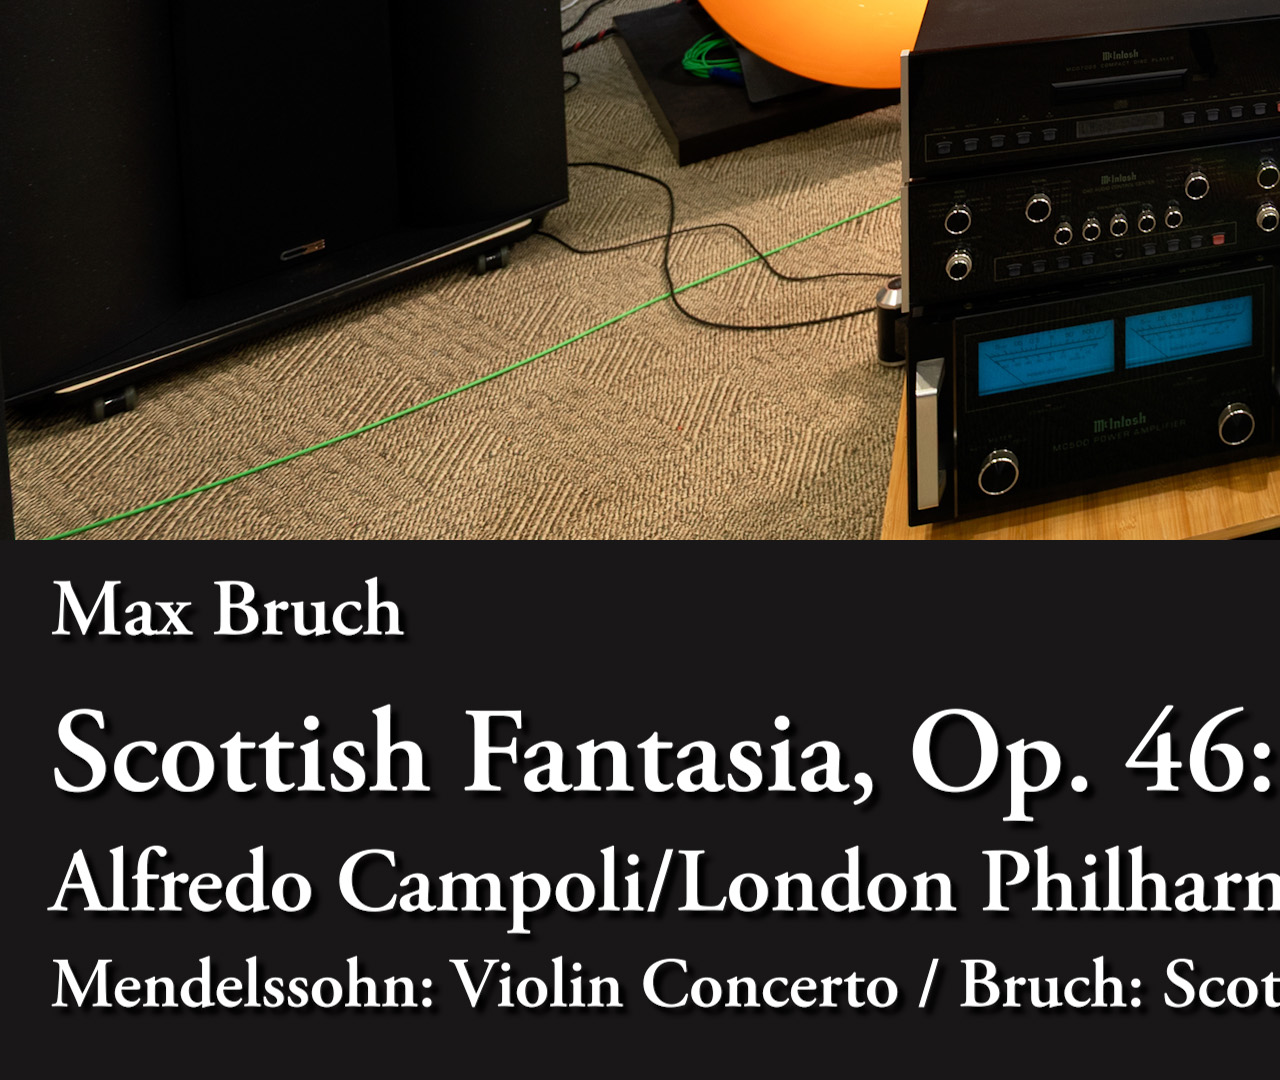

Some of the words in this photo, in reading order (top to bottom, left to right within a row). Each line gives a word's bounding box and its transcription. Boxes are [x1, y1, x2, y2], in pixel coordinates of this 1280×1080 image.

[1093, 411, 1147, 433] McIntosh
[1093, 430, 1131, 445] POWER
[1133, 417, 1187, 437] AMPLIFIER
